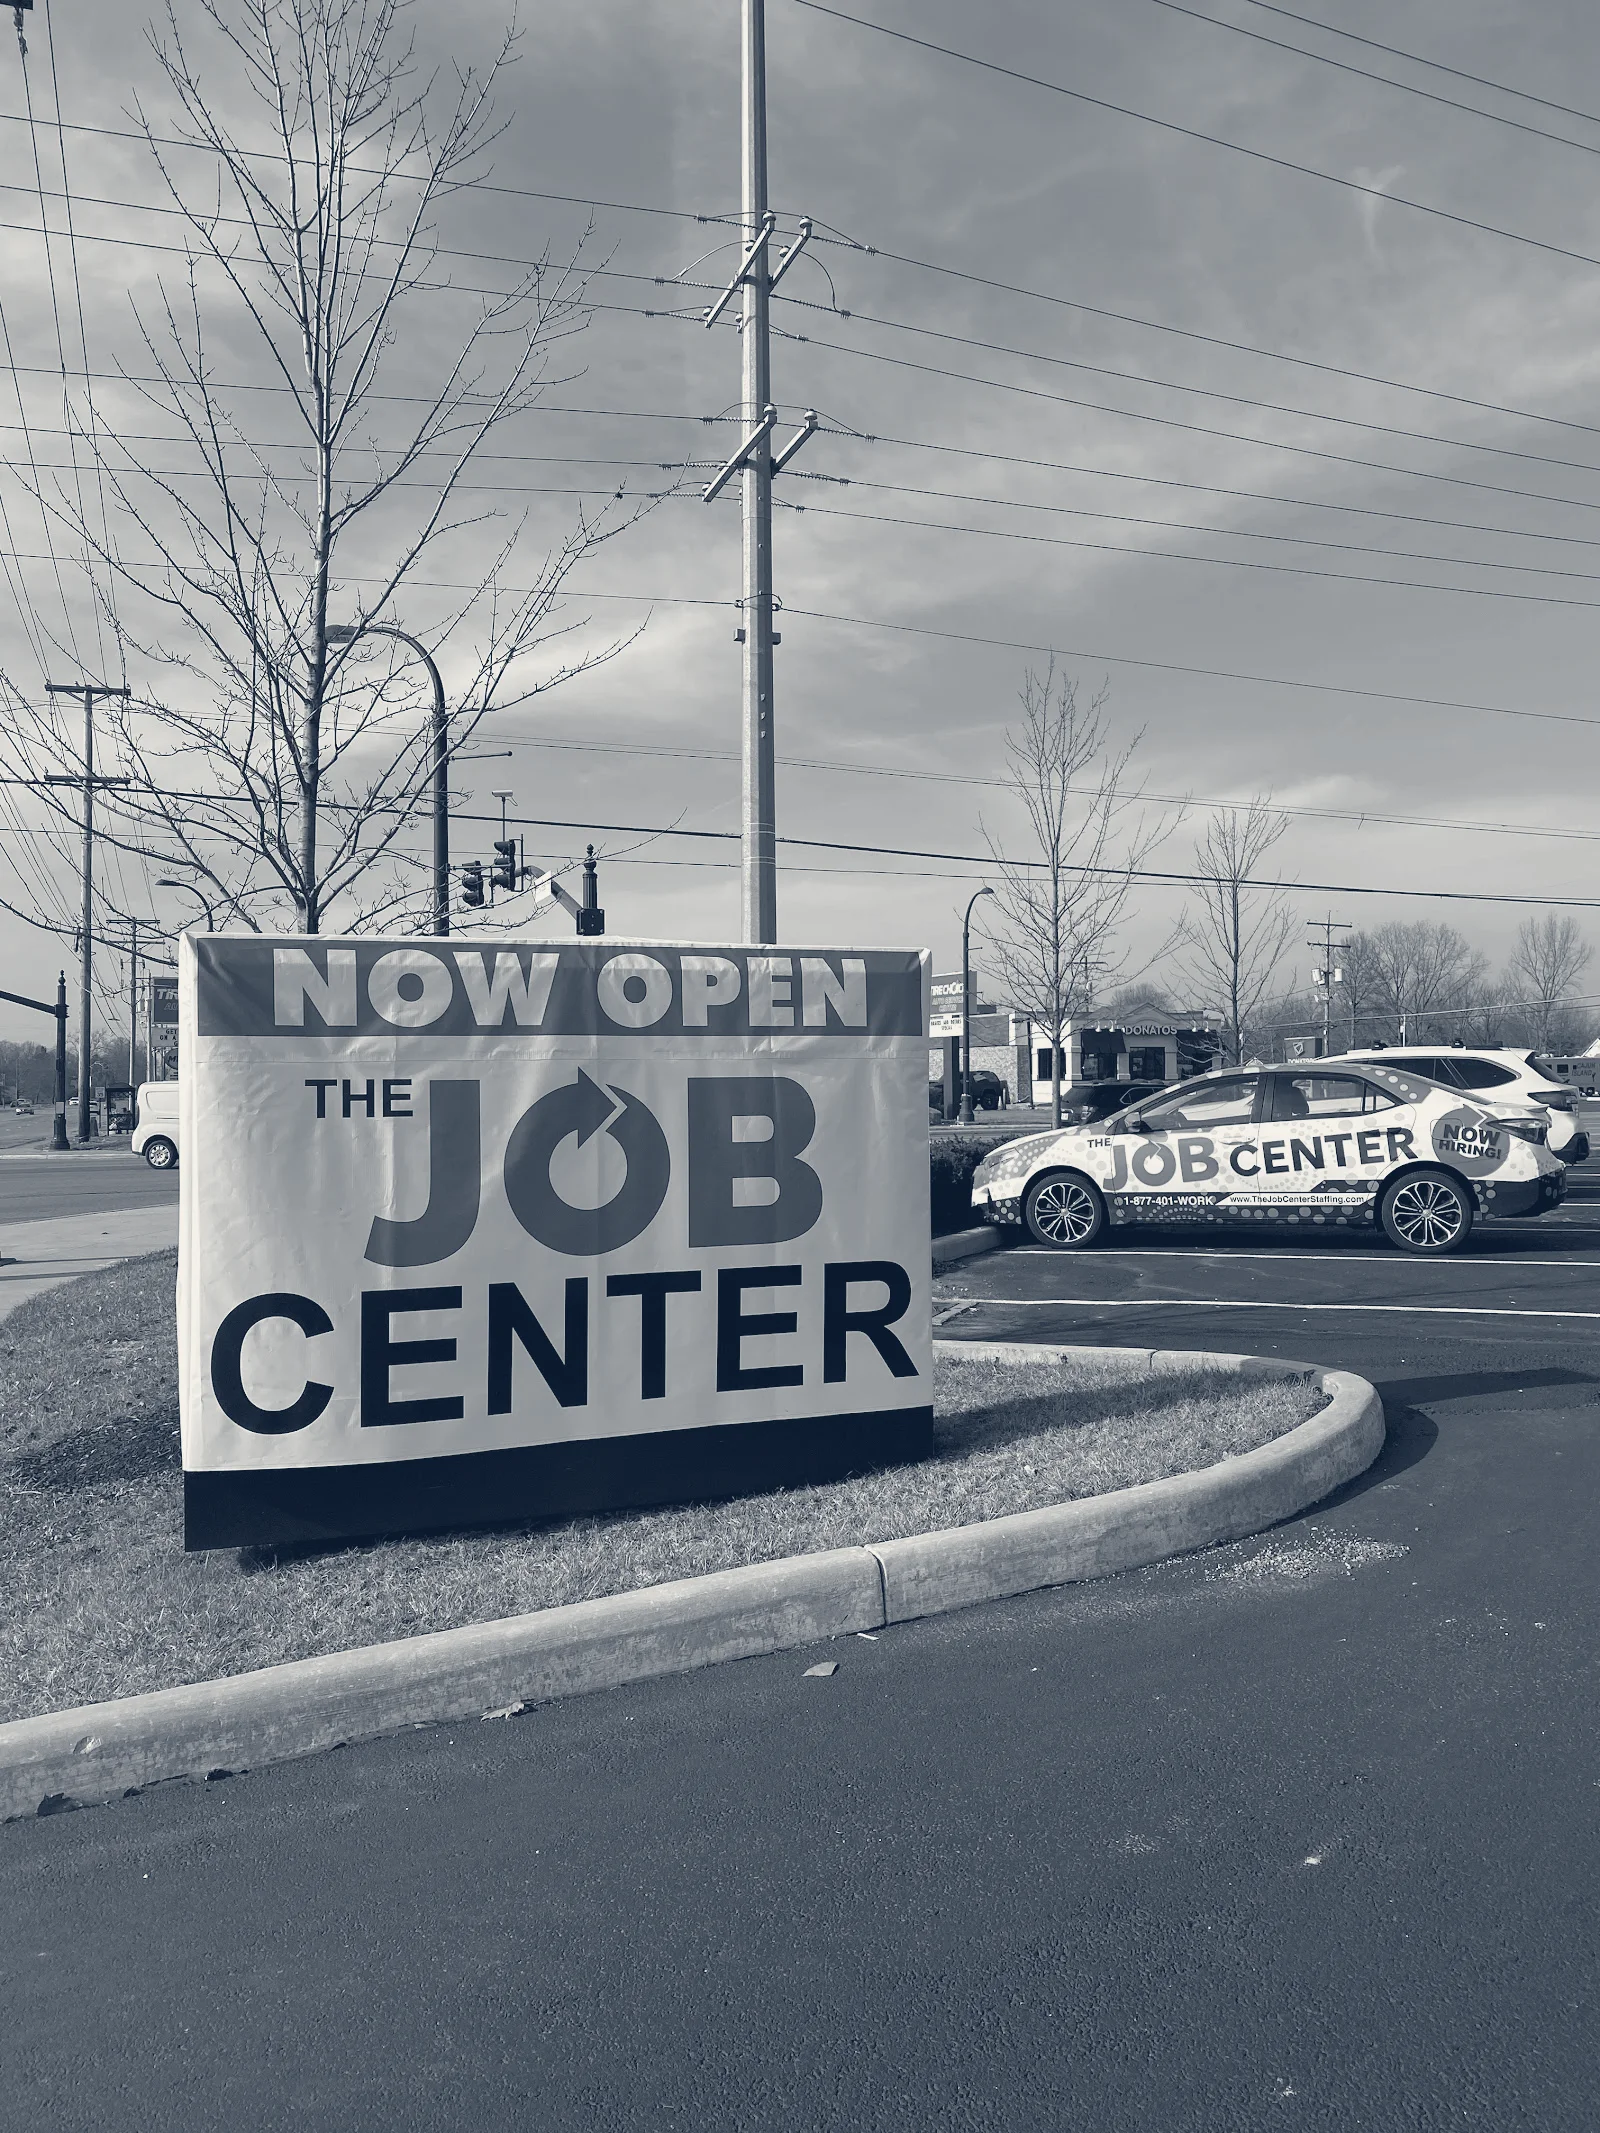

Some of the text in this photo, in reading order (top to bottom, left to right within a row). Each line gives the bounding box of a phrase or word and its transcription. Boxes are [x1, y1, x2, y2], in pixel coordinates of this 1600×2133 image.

[157, 989, 178, 1000] TIR
[273, 948, 868, 1028] NOW OPEN
[1124, 1025, 1177, 1035] DONATOS
[305, 1079, 413, 1119] THE
[1087, 1137, 1111, 1148] THE
[1443, 1123, 1501, 1146] NOW
[1230, 1126, 1418, 1177] CENTER
[1438, 1139, 1502, 1160] HIRING!
[363, 1065, 823, 1268] JOB
[1103, 1136, 1220, 1191] JOB
[1123, 1195, 1214, 1206] 1-877-401-WORK
[1229, 1194, 1365, 1205] www.TheJobCenterStaffing.com
[210, 1260, 919, 1436] CENTER
